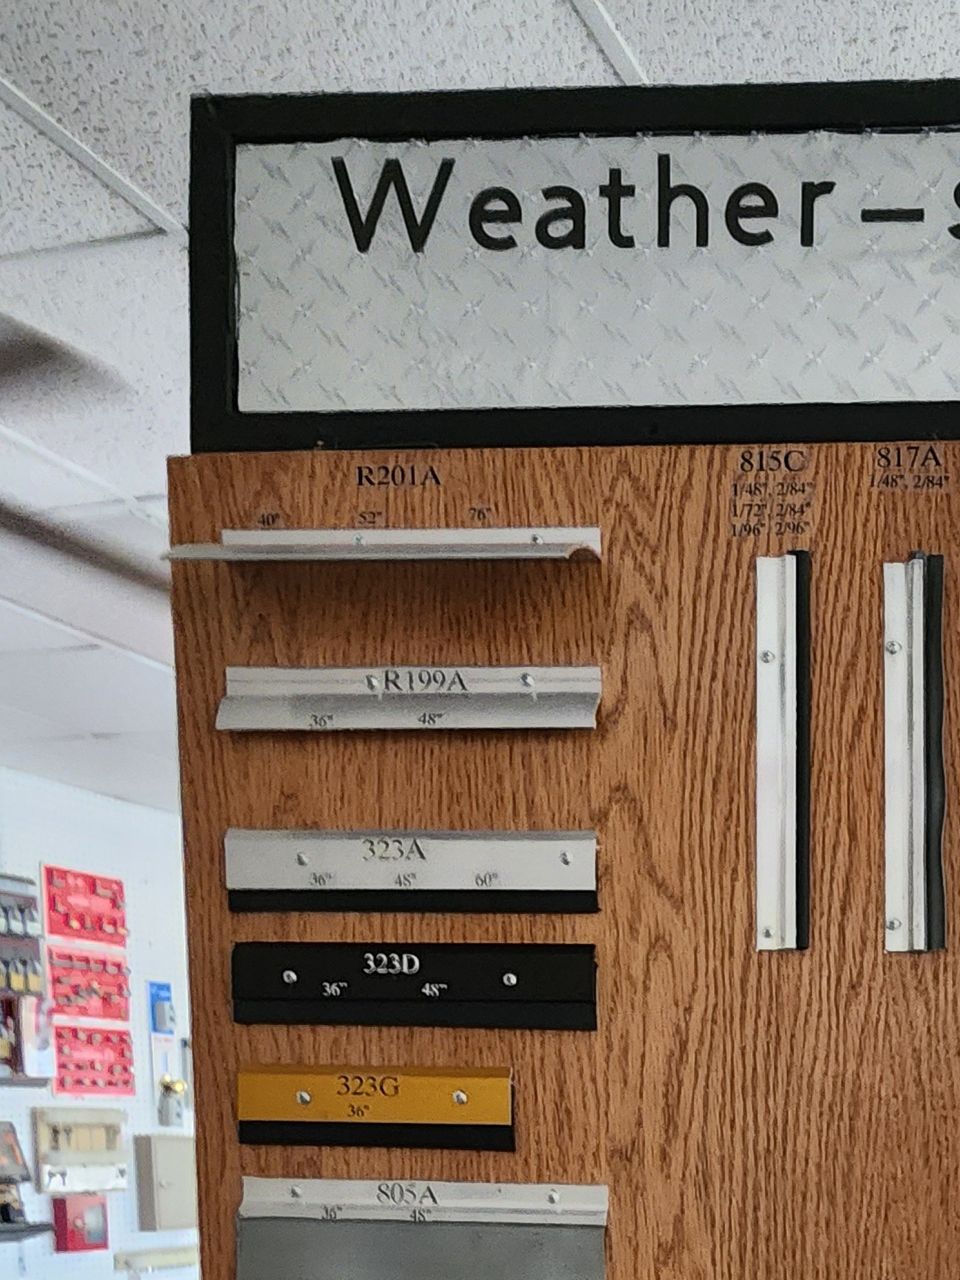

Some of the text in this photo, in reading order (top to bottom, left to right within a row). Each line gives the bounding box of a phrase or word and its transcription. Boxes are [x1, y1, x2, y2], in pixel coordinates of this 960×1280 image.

[740, 449, 807, 472] 815C
[877, 445, 943, 468] 817A
[355, 464, 443, 487] R201A
[913, 474, 950, 489] 2/84"
[257, 513, 281, 527] 40"
[358, 511, 383, 525] 52"
[383, 669, 468, 692] R199A
[309, 711, 443, 728] 36" 48"
[361, 838, 428, 862] 323A
[362, 953, 421, 975] 323D
[322, 981, 448, 998] 36" 48"
[336, 1075, 401, 1098] 323G
[347, 1104, 370, 1118] 36"
[376, 1182, 439, 1206] 805A
